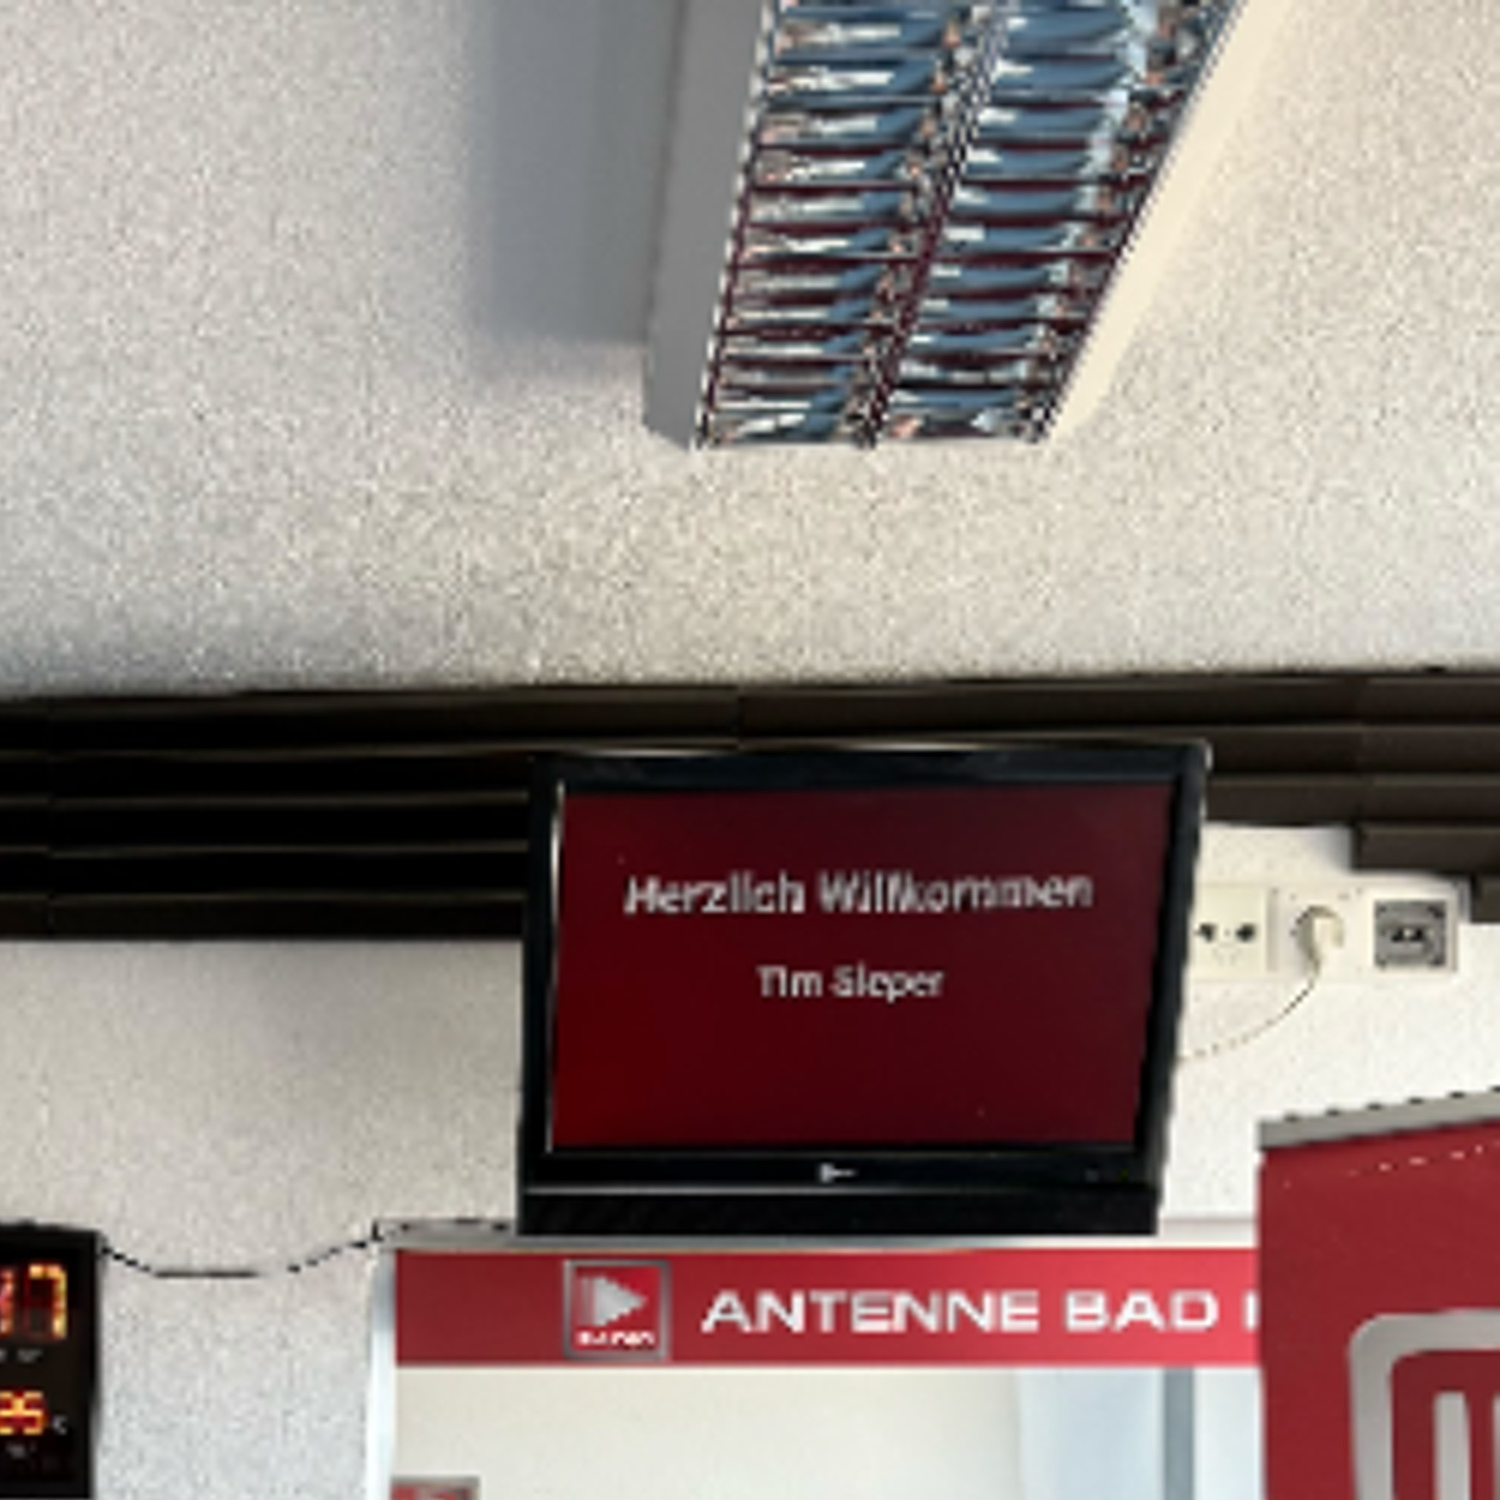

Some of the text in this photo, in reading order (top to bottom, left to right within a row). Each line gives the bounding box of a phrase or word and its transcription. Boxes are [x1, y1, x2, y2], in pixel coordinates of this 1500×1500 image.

[624, 870, 1094, 915] Herzlich Willkommen
[756, 965, 823, 997] Tim
[700, 1289, 1039, 1333] ANTENNE
[1064, 1289, 1219, 1333] BAD
